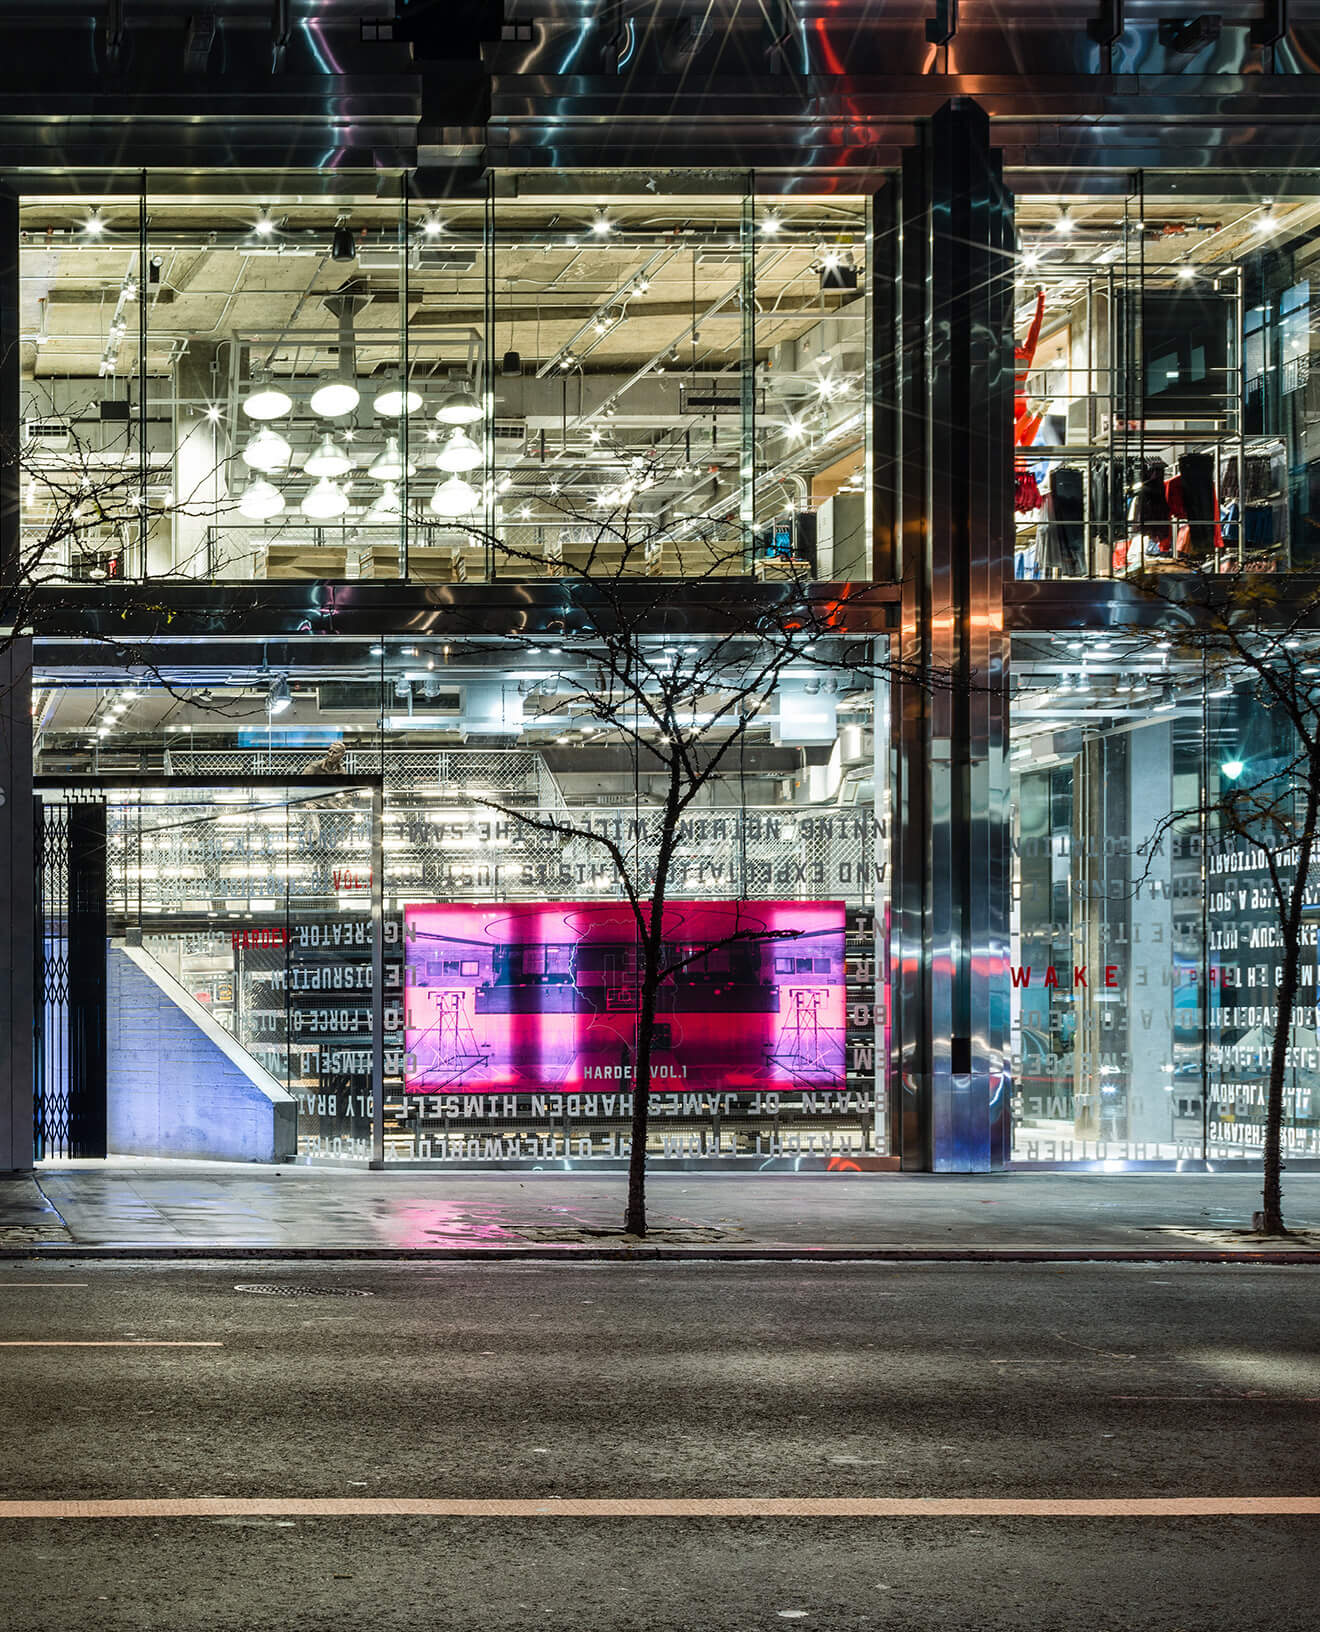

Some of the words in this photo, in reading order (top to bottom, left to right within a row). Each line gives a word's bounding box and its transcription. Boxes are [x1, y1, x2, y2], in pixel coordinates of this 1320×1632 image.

[232, 928, 291, 951] HARDEN
[1010, 965, 1119, 988] WAKE
[584, 1064, 637, 1079] HARDE
[531, 1094, 633, 1118] HARDEN
[747, 1091, 780, 1114] OF
